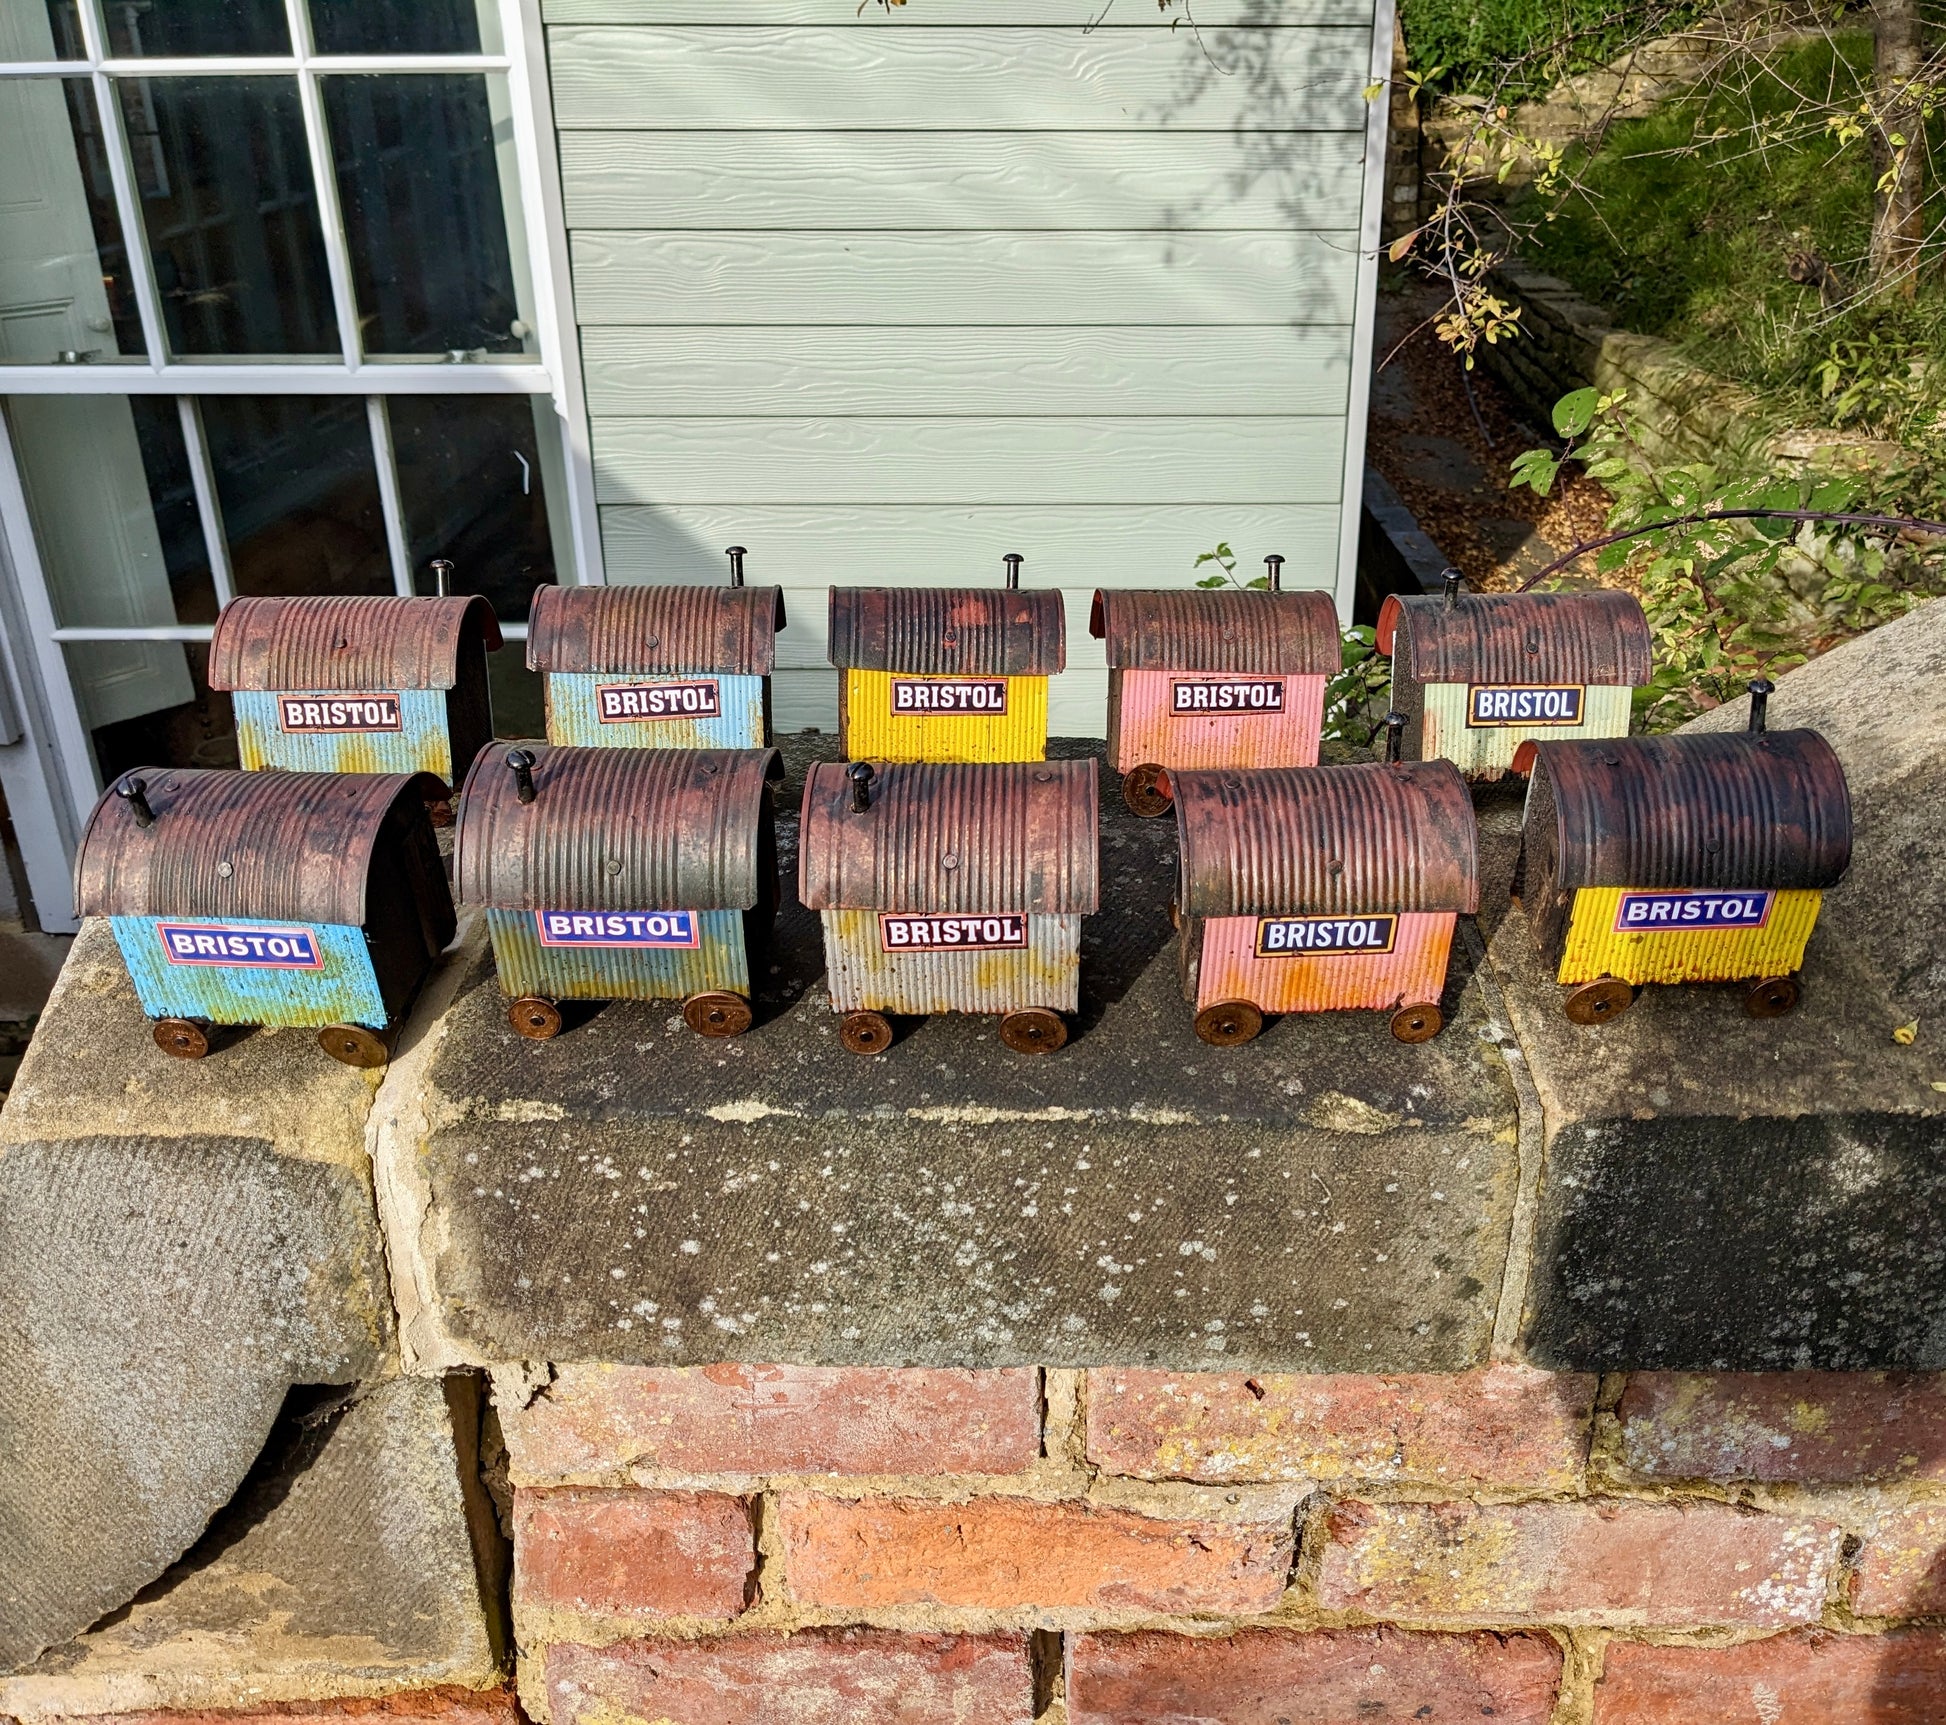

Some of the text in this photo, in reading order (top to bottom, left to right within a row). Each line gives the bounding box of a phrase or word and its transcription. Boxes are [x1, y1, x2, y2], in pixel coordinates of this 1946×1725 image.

[603, 688, 715, 715] BRISTOL
[897, 685, 1003, 708] BRISTOL
[1176, 684, 1281, 708] BRISTOL
[1478, 691, 1573, 717] BRISTOL
[286, 702, 397, 725] BRISTOL
[1626, 899, 1758, 921] BRISTOL
[549, 916, 688, 937] BRISTOL
[888, 919, 1021, 944] BRISTOL
[1267, 921, 1382, 949] BRISTOL
[171, 933, 310, 958] BRISTOL
